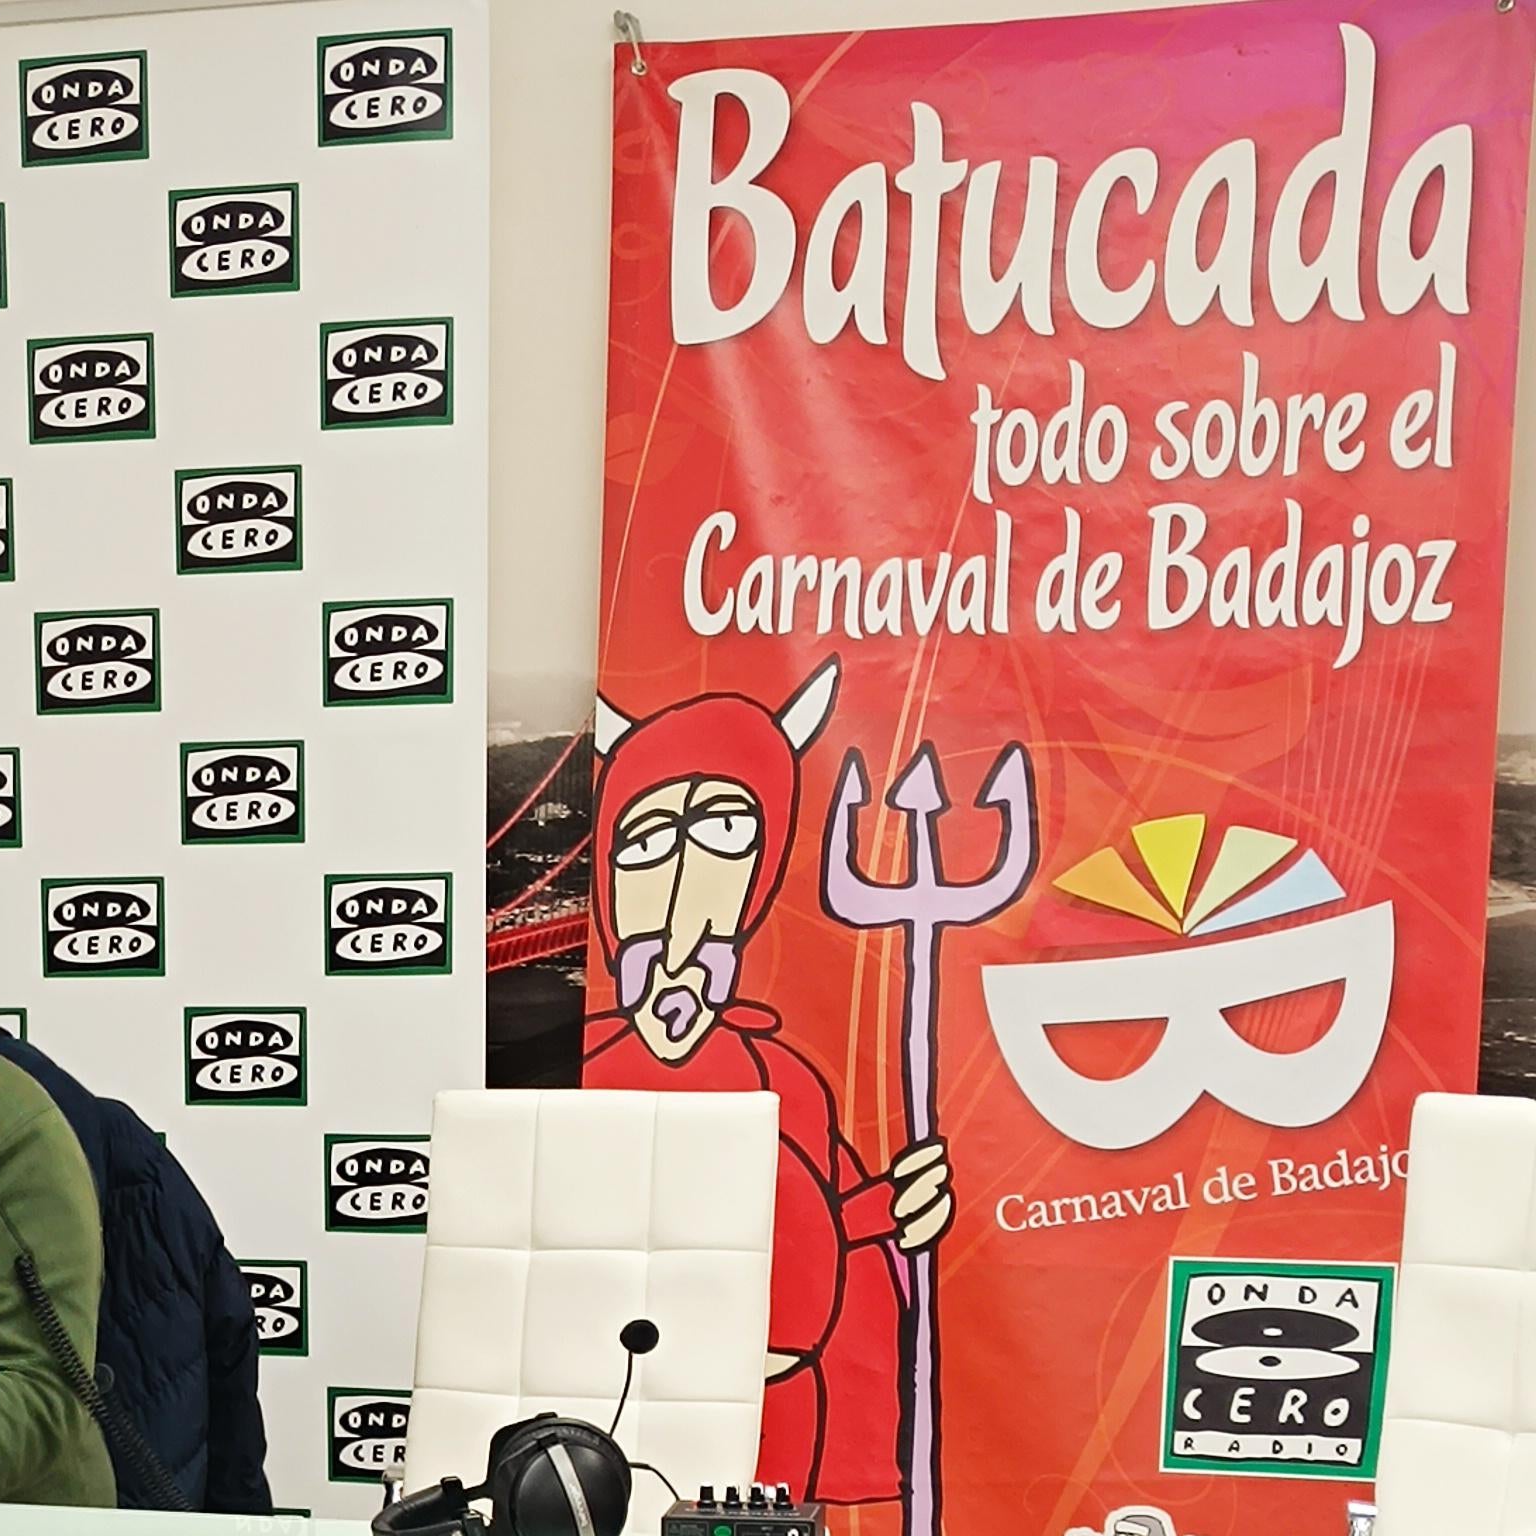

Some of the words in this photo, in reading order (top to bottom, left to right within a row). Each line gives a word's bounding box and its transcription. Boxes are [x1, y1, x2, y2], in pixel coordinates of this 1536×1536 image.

[339, 56, 428, 82] ONDA
[41, 79, 125, 104] ONDA
[345, 95, 427, 121] CERO
[47, 116, 125, 142] CERO
[667, 22, 1474, 381] Batucada
[190, 210, 275, 235] ONDA
[196, 248, 276, 273] CERO
[341, 344, 429, 368] ONDA
[48, 360, 131, 383] ONDA
[347, 381, 428, 405] CERO
[54, 396, 132, 420] CERO
[970, 359, 1128, 505] todo
[1149, 351, 1367, 480] sobre
[1389, 341, 1457, 469] el
[195, 491, 279, 514] ONDA
[201, 527, 279, 551] CERO
[683, 509, 1013, 640] Carnaval
[1035, 506, 1123, 634] de
[1147, 498, 1457, 669] Badajoz
[55, 634, 137, 656] ONDA
[344, 624, 429, 647] ONDA
[61, 669, 138, 692] CERO
[348, 660, 429, 684] CERO
[200, 765, 282, 786] ONDA
[206, 800, 282, 822] CERO
[61, 901, 142, 921] ONDA
[345, 897, 429, 918] ONDA
[67, 935, 142, 956] CERO
[350, 932, 428, 954] CERO
[204, 1031, 284, 1050] ONDA
[209, 1064, 284, 1085] CERO
[344, 1158, 426, 1177] ONDA
[995, 1172, 1191, 1232] Carnaval
[1202, 1166, 1258, 1205] de
[1268, 1144, 1410, 1197] Badajo
[350, 1191, 426, 1212] CERO
[250, 1283, 285, 1299] DA
[1207, 1283, 1360, 1309] ONDA
[1183, 1387, 1351, 1427] CERO
[348, 1411, 407, 1429] OND
[353, 1444, 407, 1463] CER
[1183, 1437, 1348, 1457] RADIO
